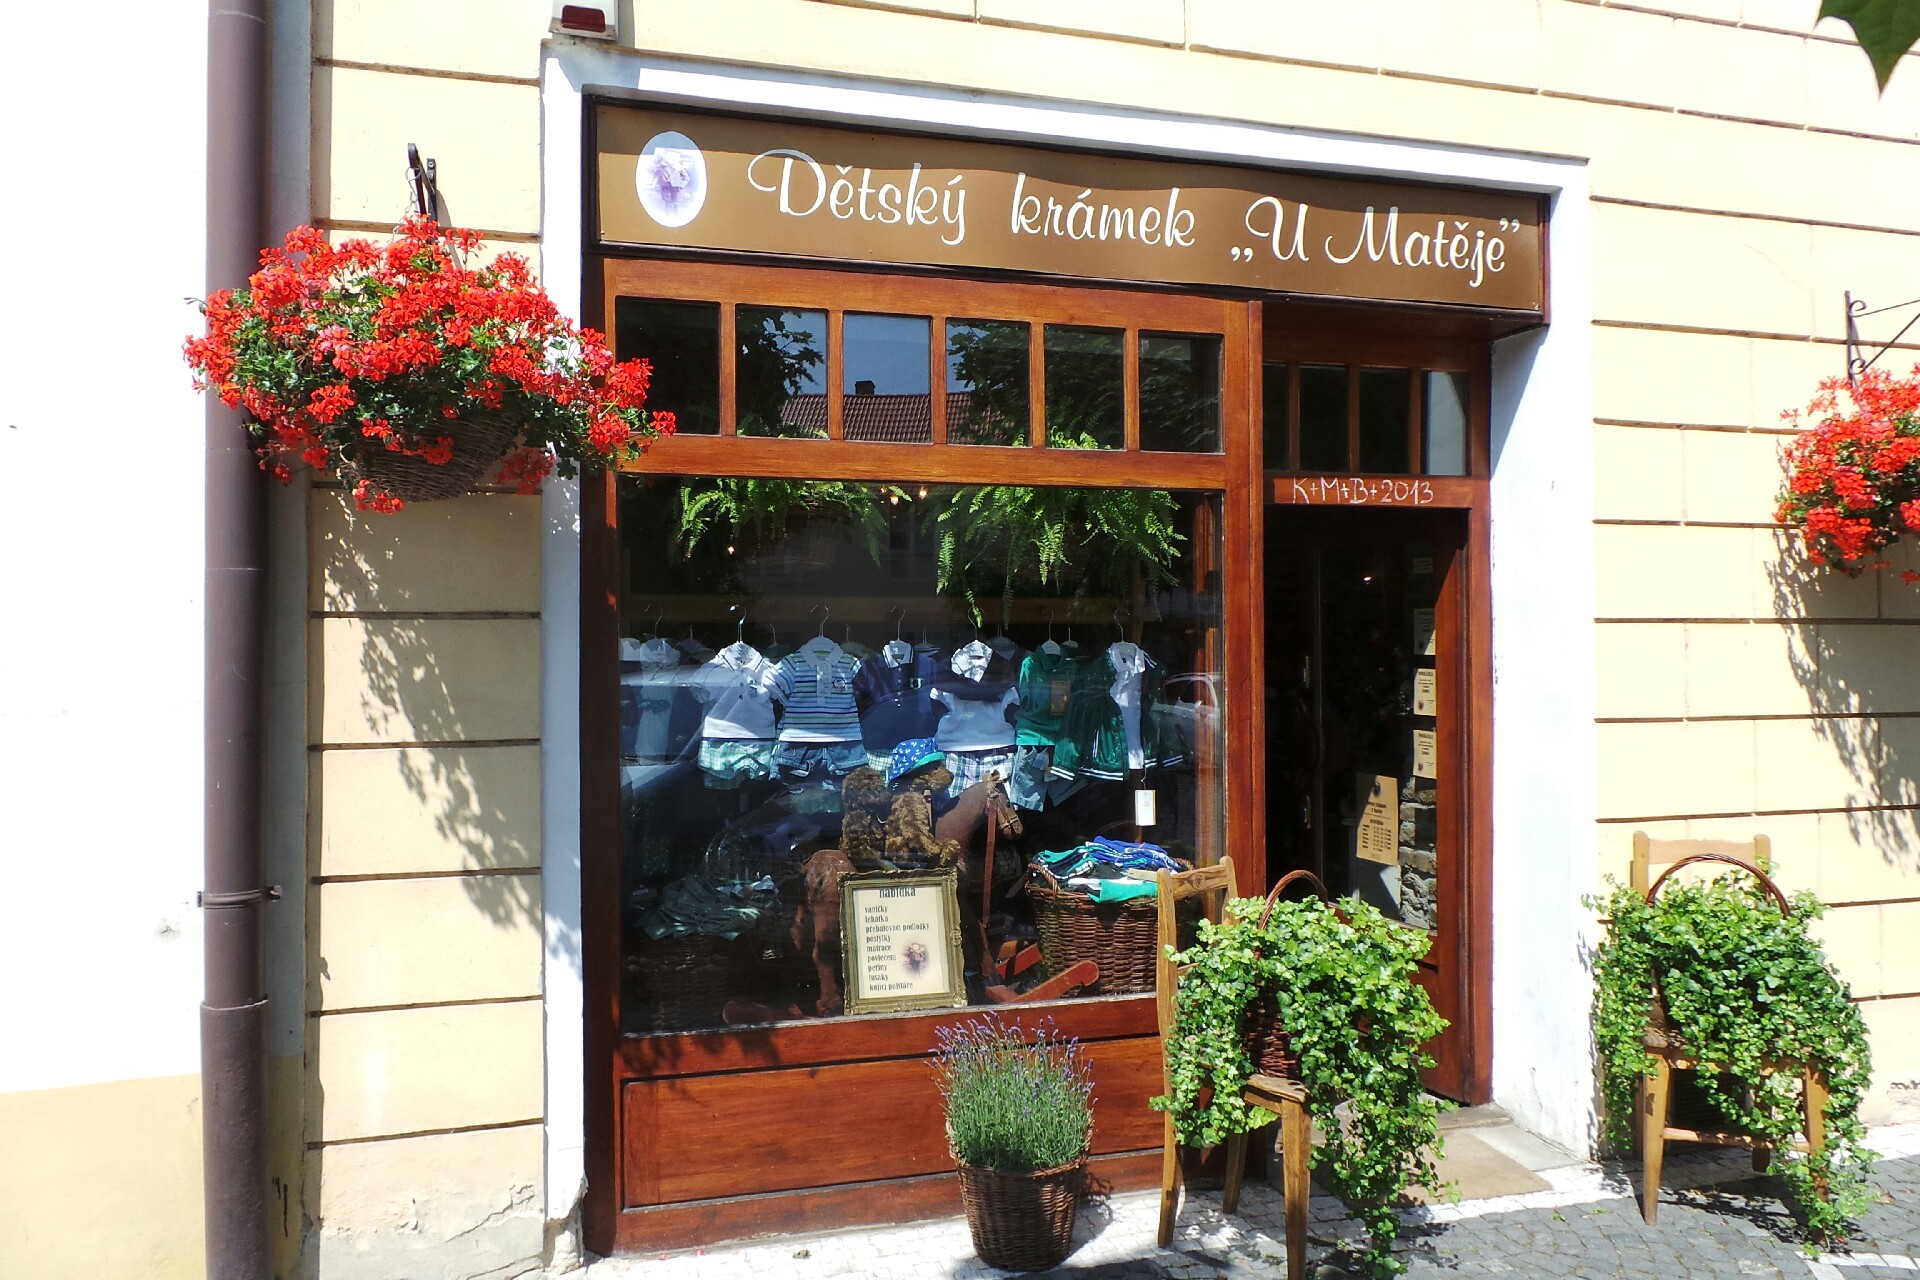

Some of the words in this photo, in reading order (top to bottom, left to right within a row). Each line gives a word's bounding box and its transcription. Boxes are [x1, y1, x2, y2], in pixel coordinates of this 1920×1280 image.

[747, 149, 966, 246] Dětský
[1011, 172, 1196, 247] krámek
[1293, 475, 1434, 505] K+M+B+2013
[866, 944, 892, 952] matrace
